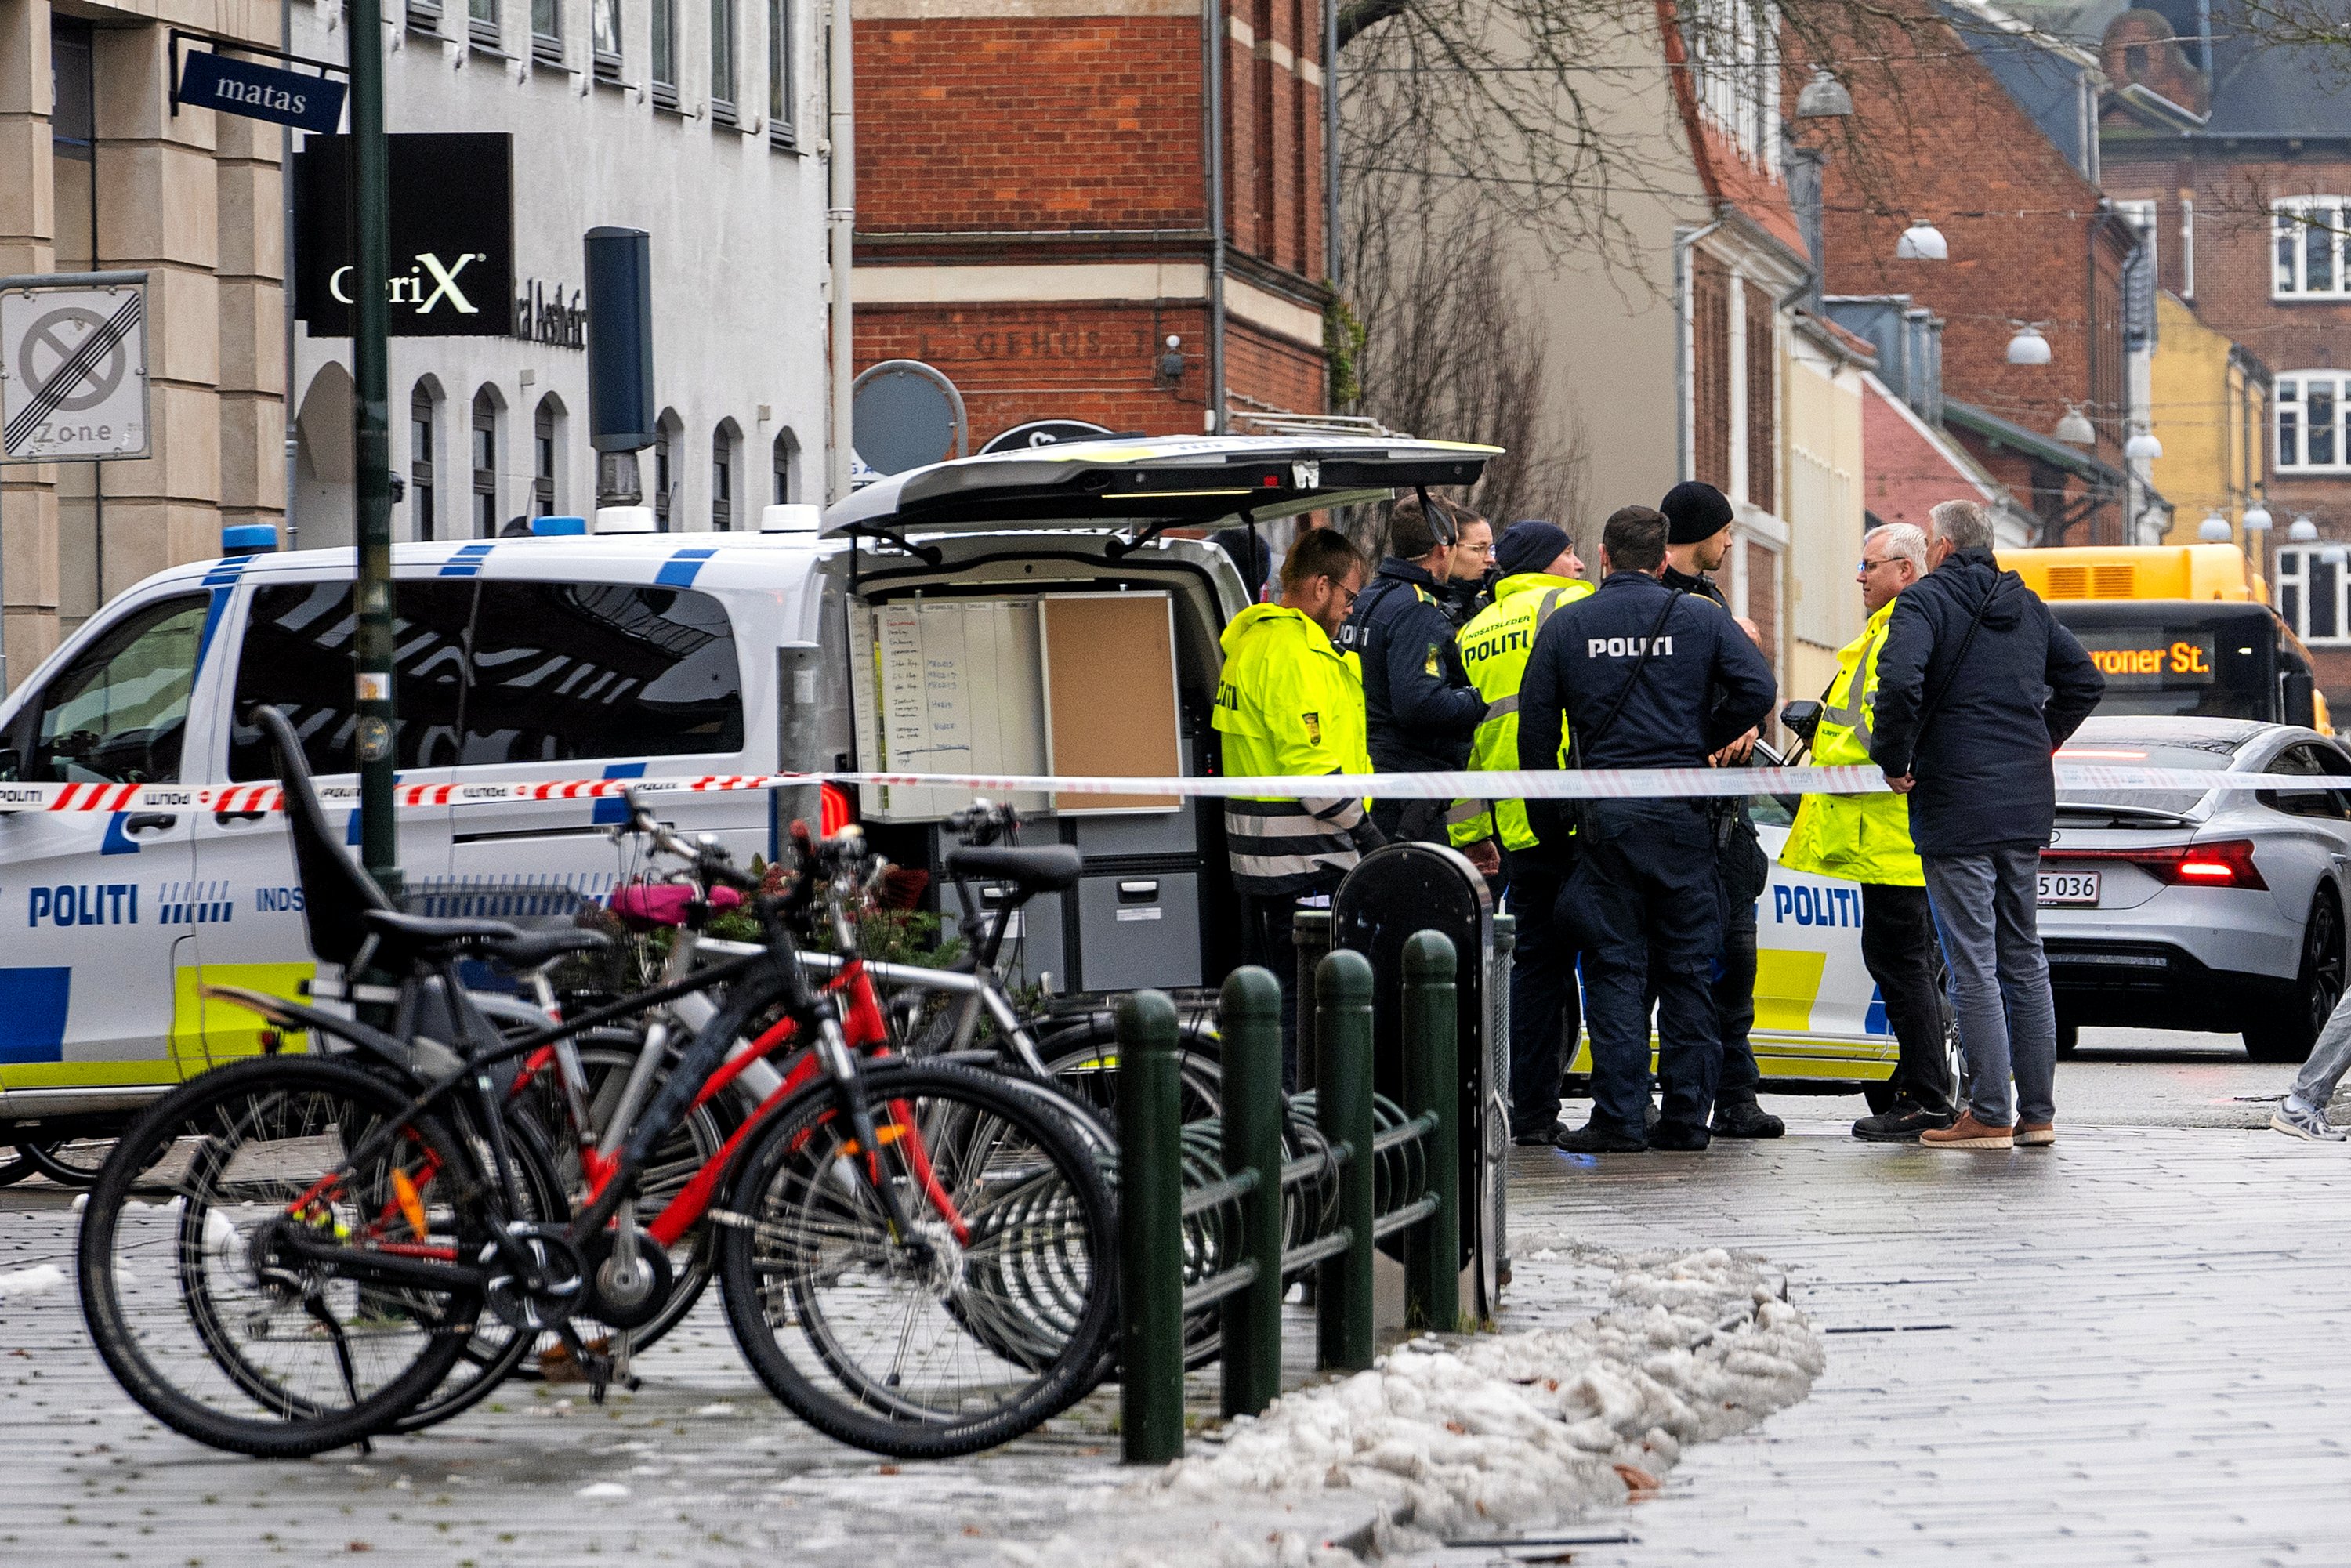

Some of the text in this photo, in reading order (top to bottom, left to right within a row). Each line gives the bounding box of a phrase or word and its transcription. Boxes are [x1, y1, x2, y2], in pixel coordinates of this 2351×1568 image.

[216, 78, 307, 114] matas
[329, 252, 479, 314] CriX
[34, 422, 111, 443] Zone
[1465, 615, 1531, 641] INDSATSLEDER
[1464, 629, 1528, 668] POLITI
[1588, 636, 1673, 658] POLITI
[2088, 641, 2210, 674] roner St.
[2056, 877, 2095, 896] 036
[29, 884, 139, 928] POLITI
[1773, 884, 1861, 929] POLITI
